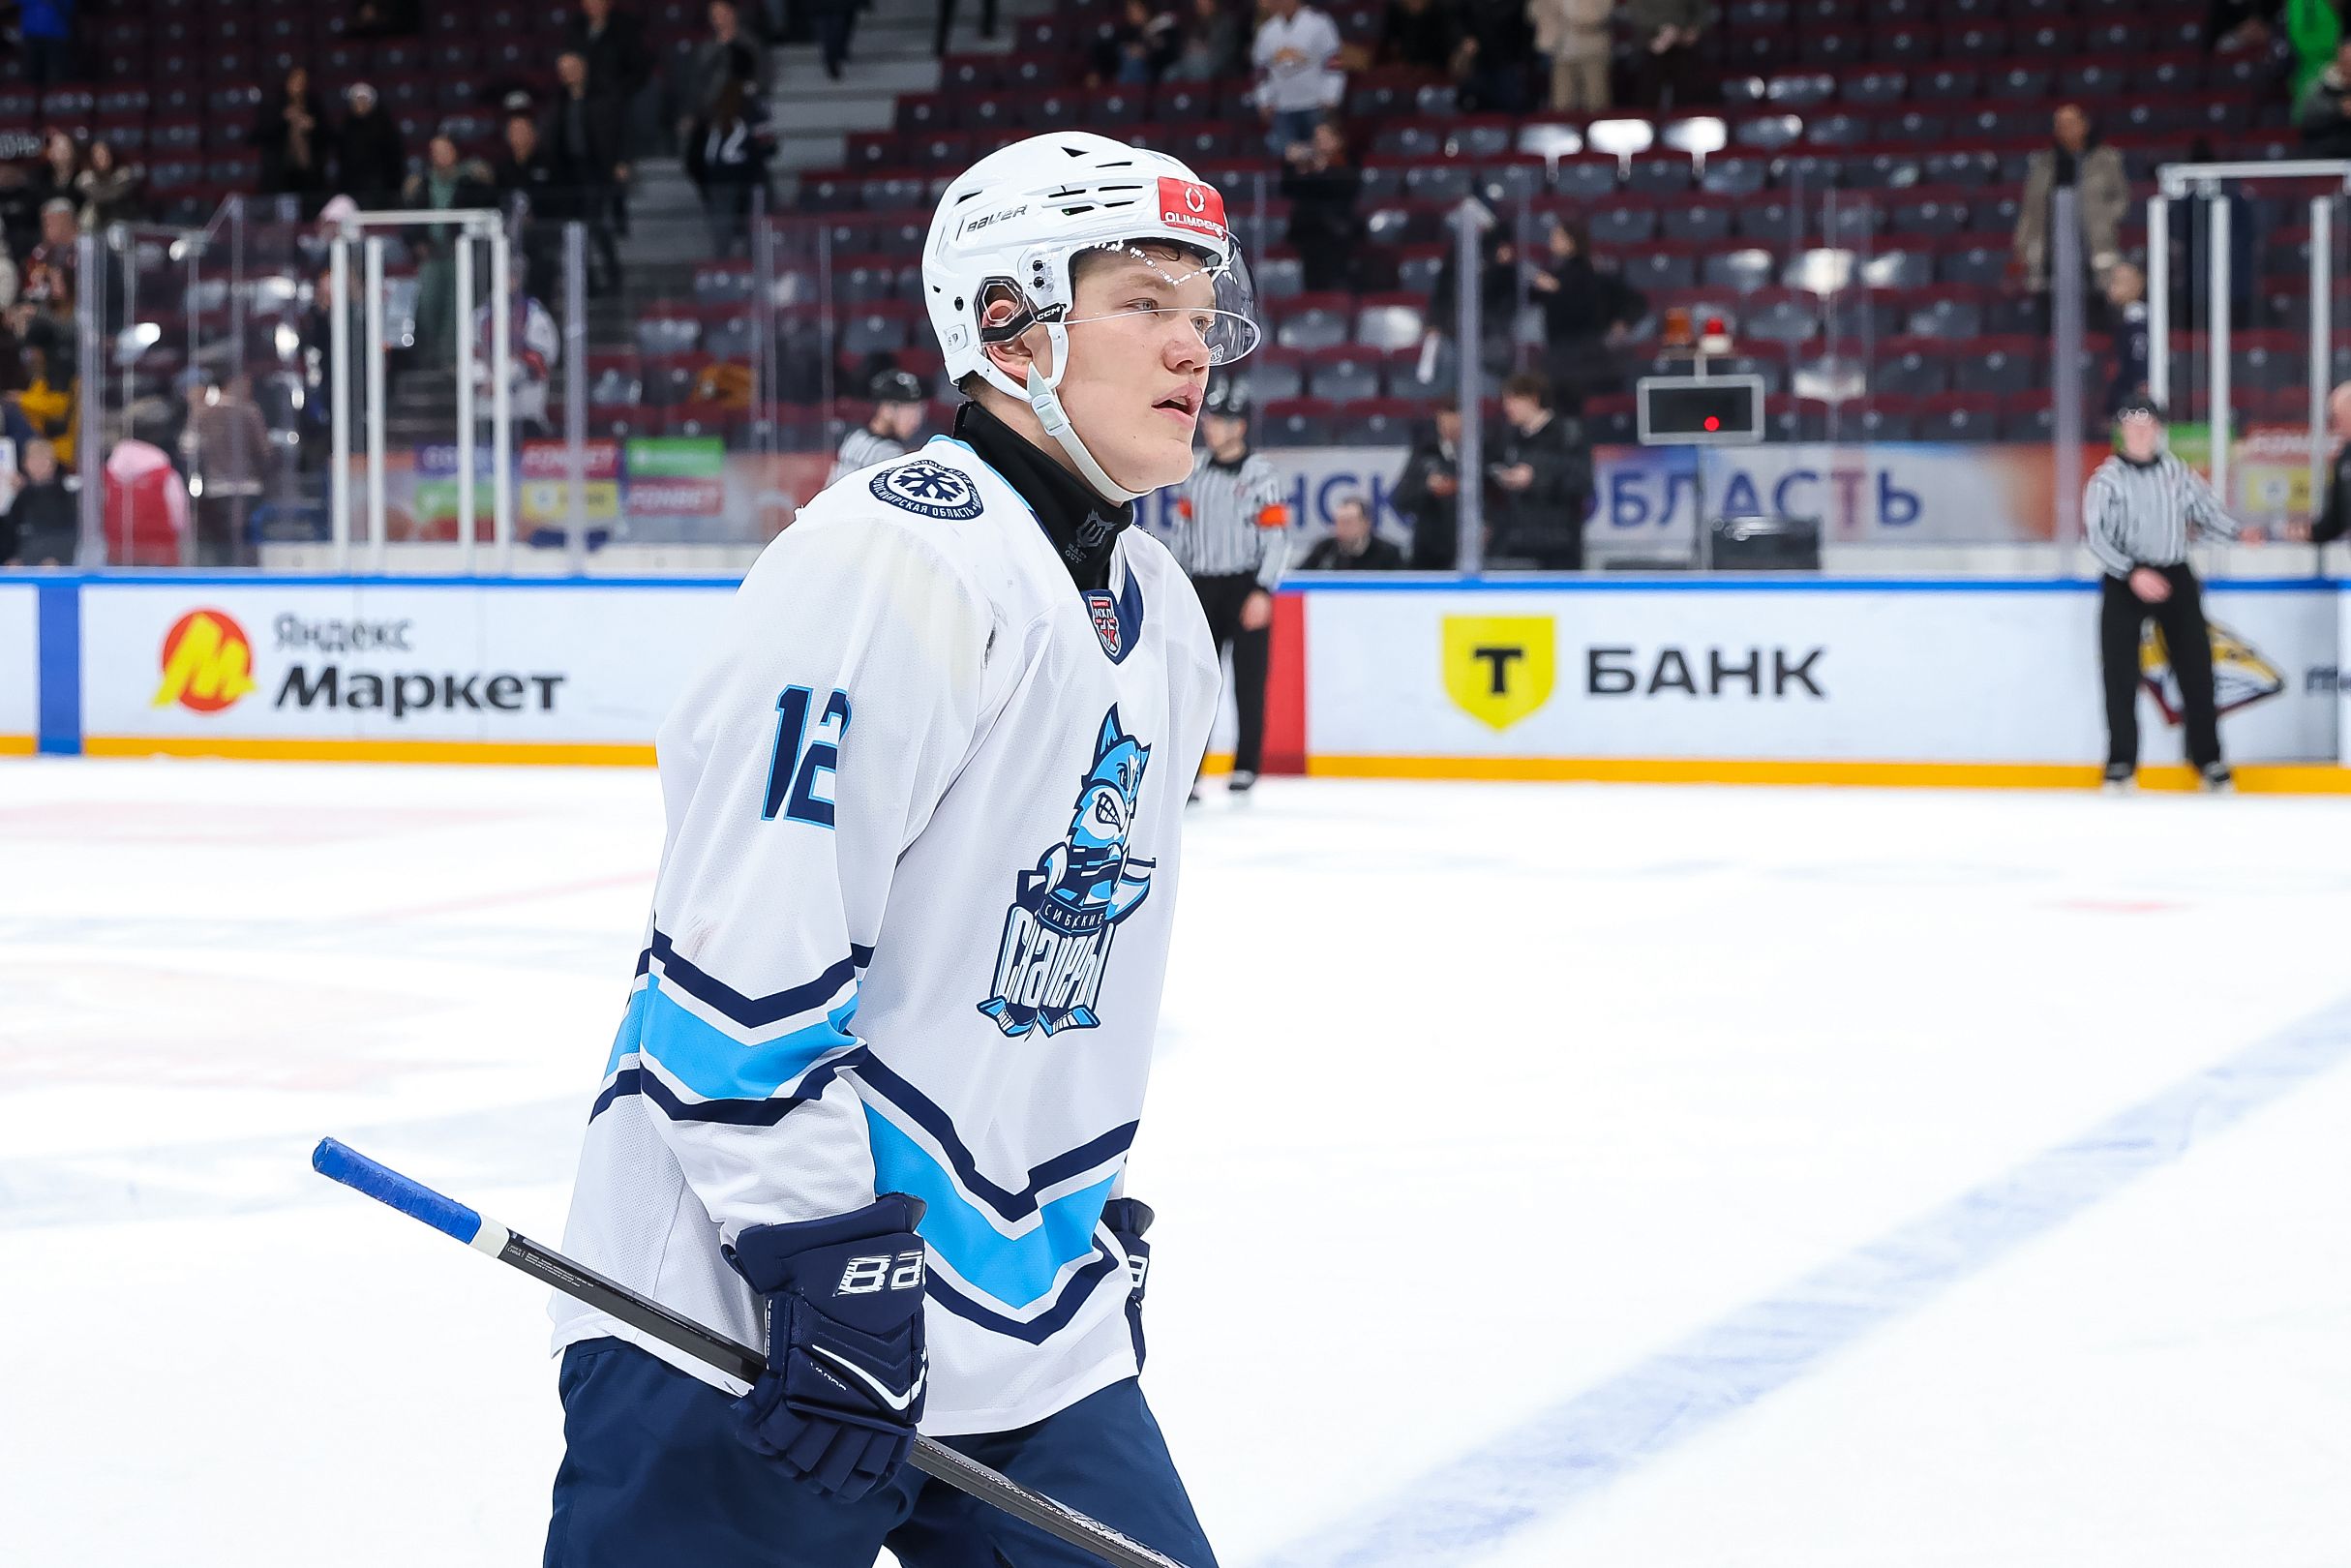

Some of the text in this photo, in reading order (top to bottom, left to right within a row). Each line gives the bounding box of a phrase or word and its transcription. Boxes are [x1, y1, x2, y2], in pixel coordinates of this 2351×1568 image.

[967, 204, 1028, 232] BAUER
[1037, 306, 1061, 320] CCM
[932, 506, 975, 518] ОБЛАСТЬ
[1590, 470, 1921, 529] БЛАСТЬ
[276, 615, 411, 651] Яндекс
[276, 665, 565, 717] Маркет
[1588, 648, 1826, 697] БАНК
[761, 683, 853, 830] 12
